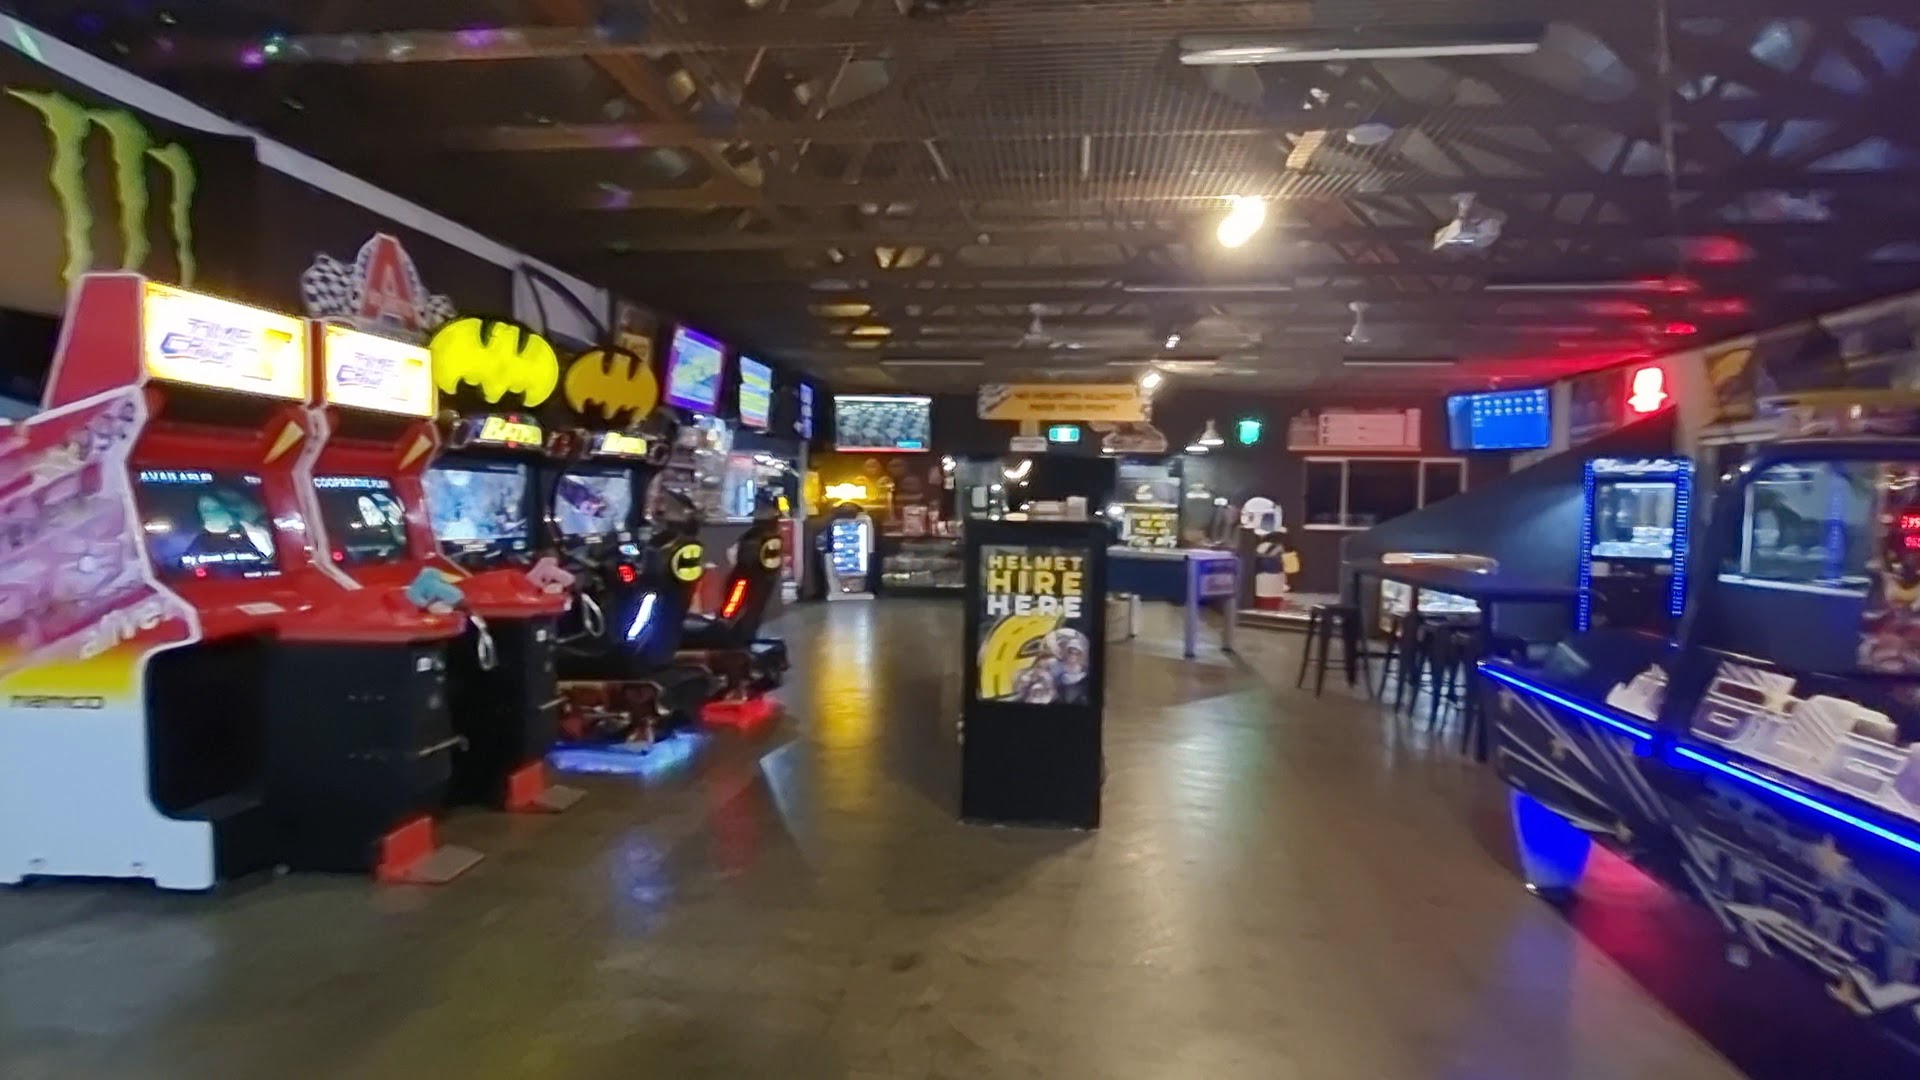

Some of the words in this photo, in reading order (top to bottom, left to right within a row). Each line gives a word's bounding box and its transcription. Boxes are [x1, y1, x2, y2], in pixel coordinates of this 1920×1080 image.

[987, 555, 1084, 571] HELMET
[987, 570, 1084, 596] HIRE
[987, 594, 1083, 618] HERE
